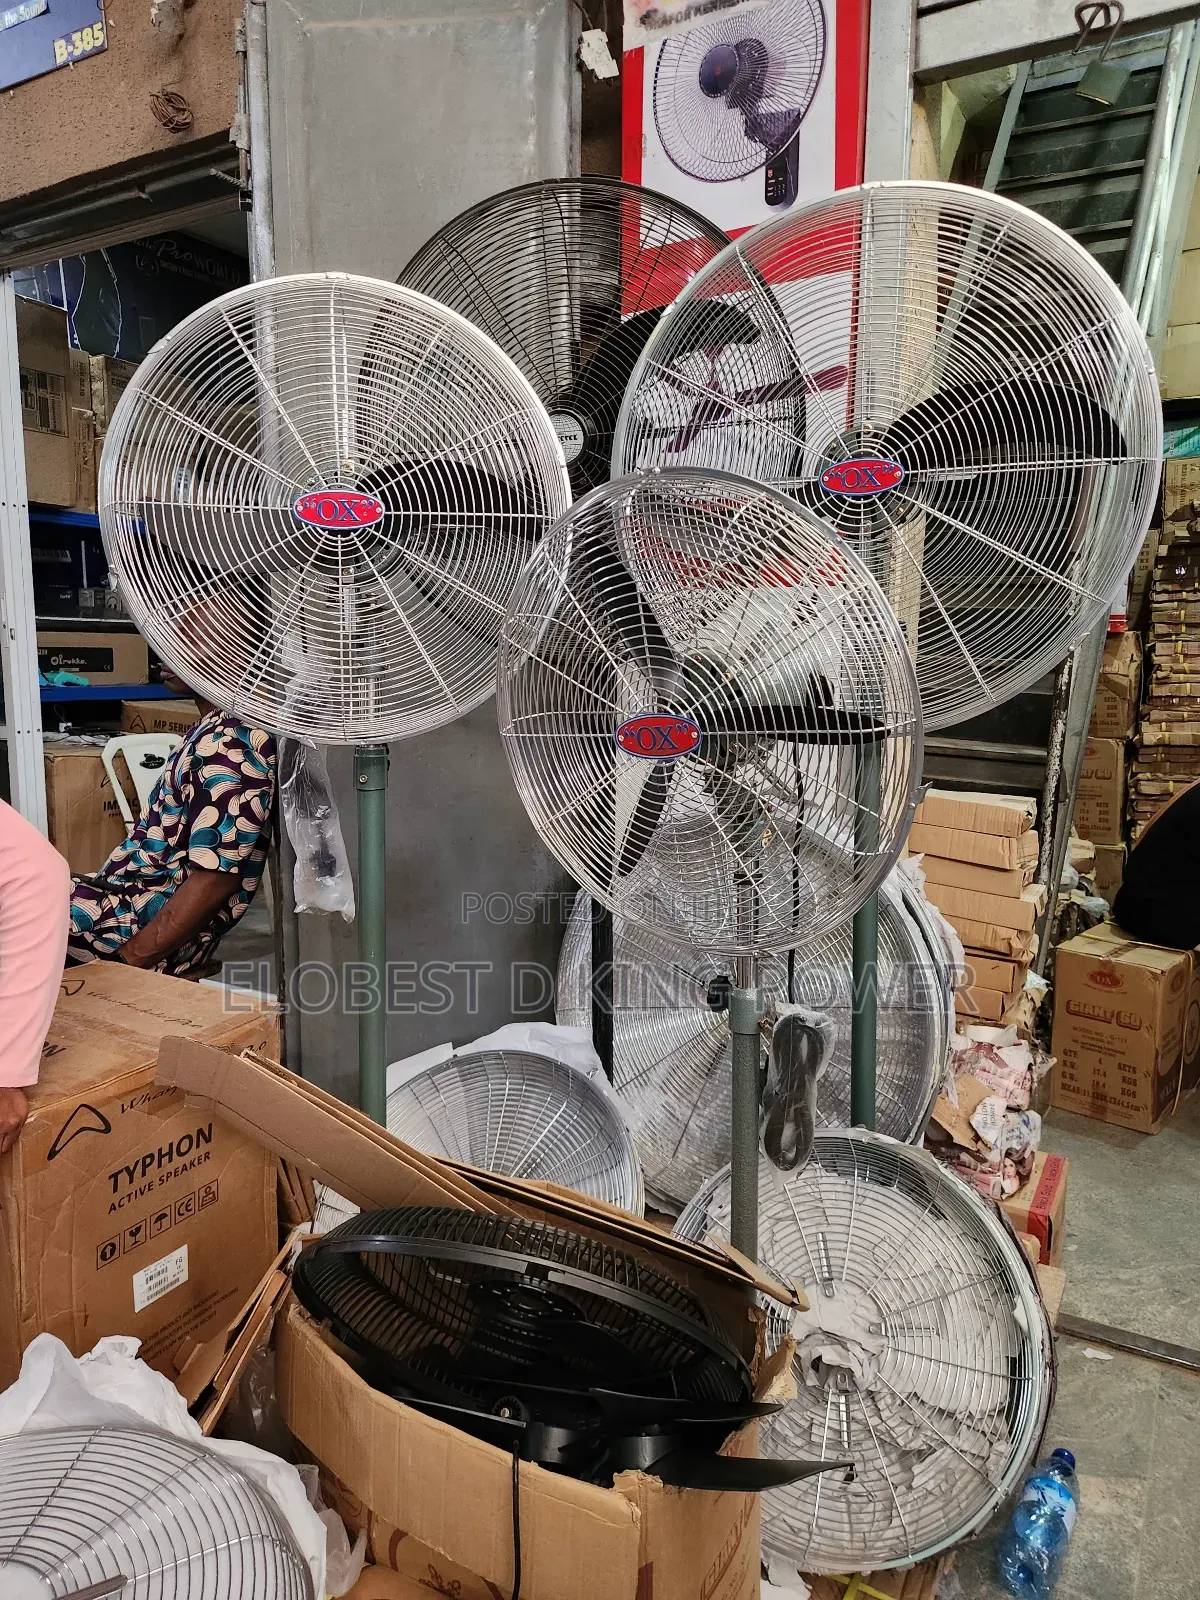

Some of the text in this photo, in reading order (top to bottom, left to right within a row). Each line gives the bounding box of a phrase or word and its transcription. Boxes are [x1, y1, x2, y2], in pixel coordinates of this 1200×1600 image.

[54, 21, 105, 66] B-385
[154, 719, 167, 730] MP
[1117, 1062, 1137, 1075] SETS
[1121, 1075, 1138, 1087] KGS
[1120, 1087, 1137, 1099] KGS
[108, 1123, 213, 1194] TYPHON
[108, 1151, 212, 1215] ACTIVE SPEAKER
